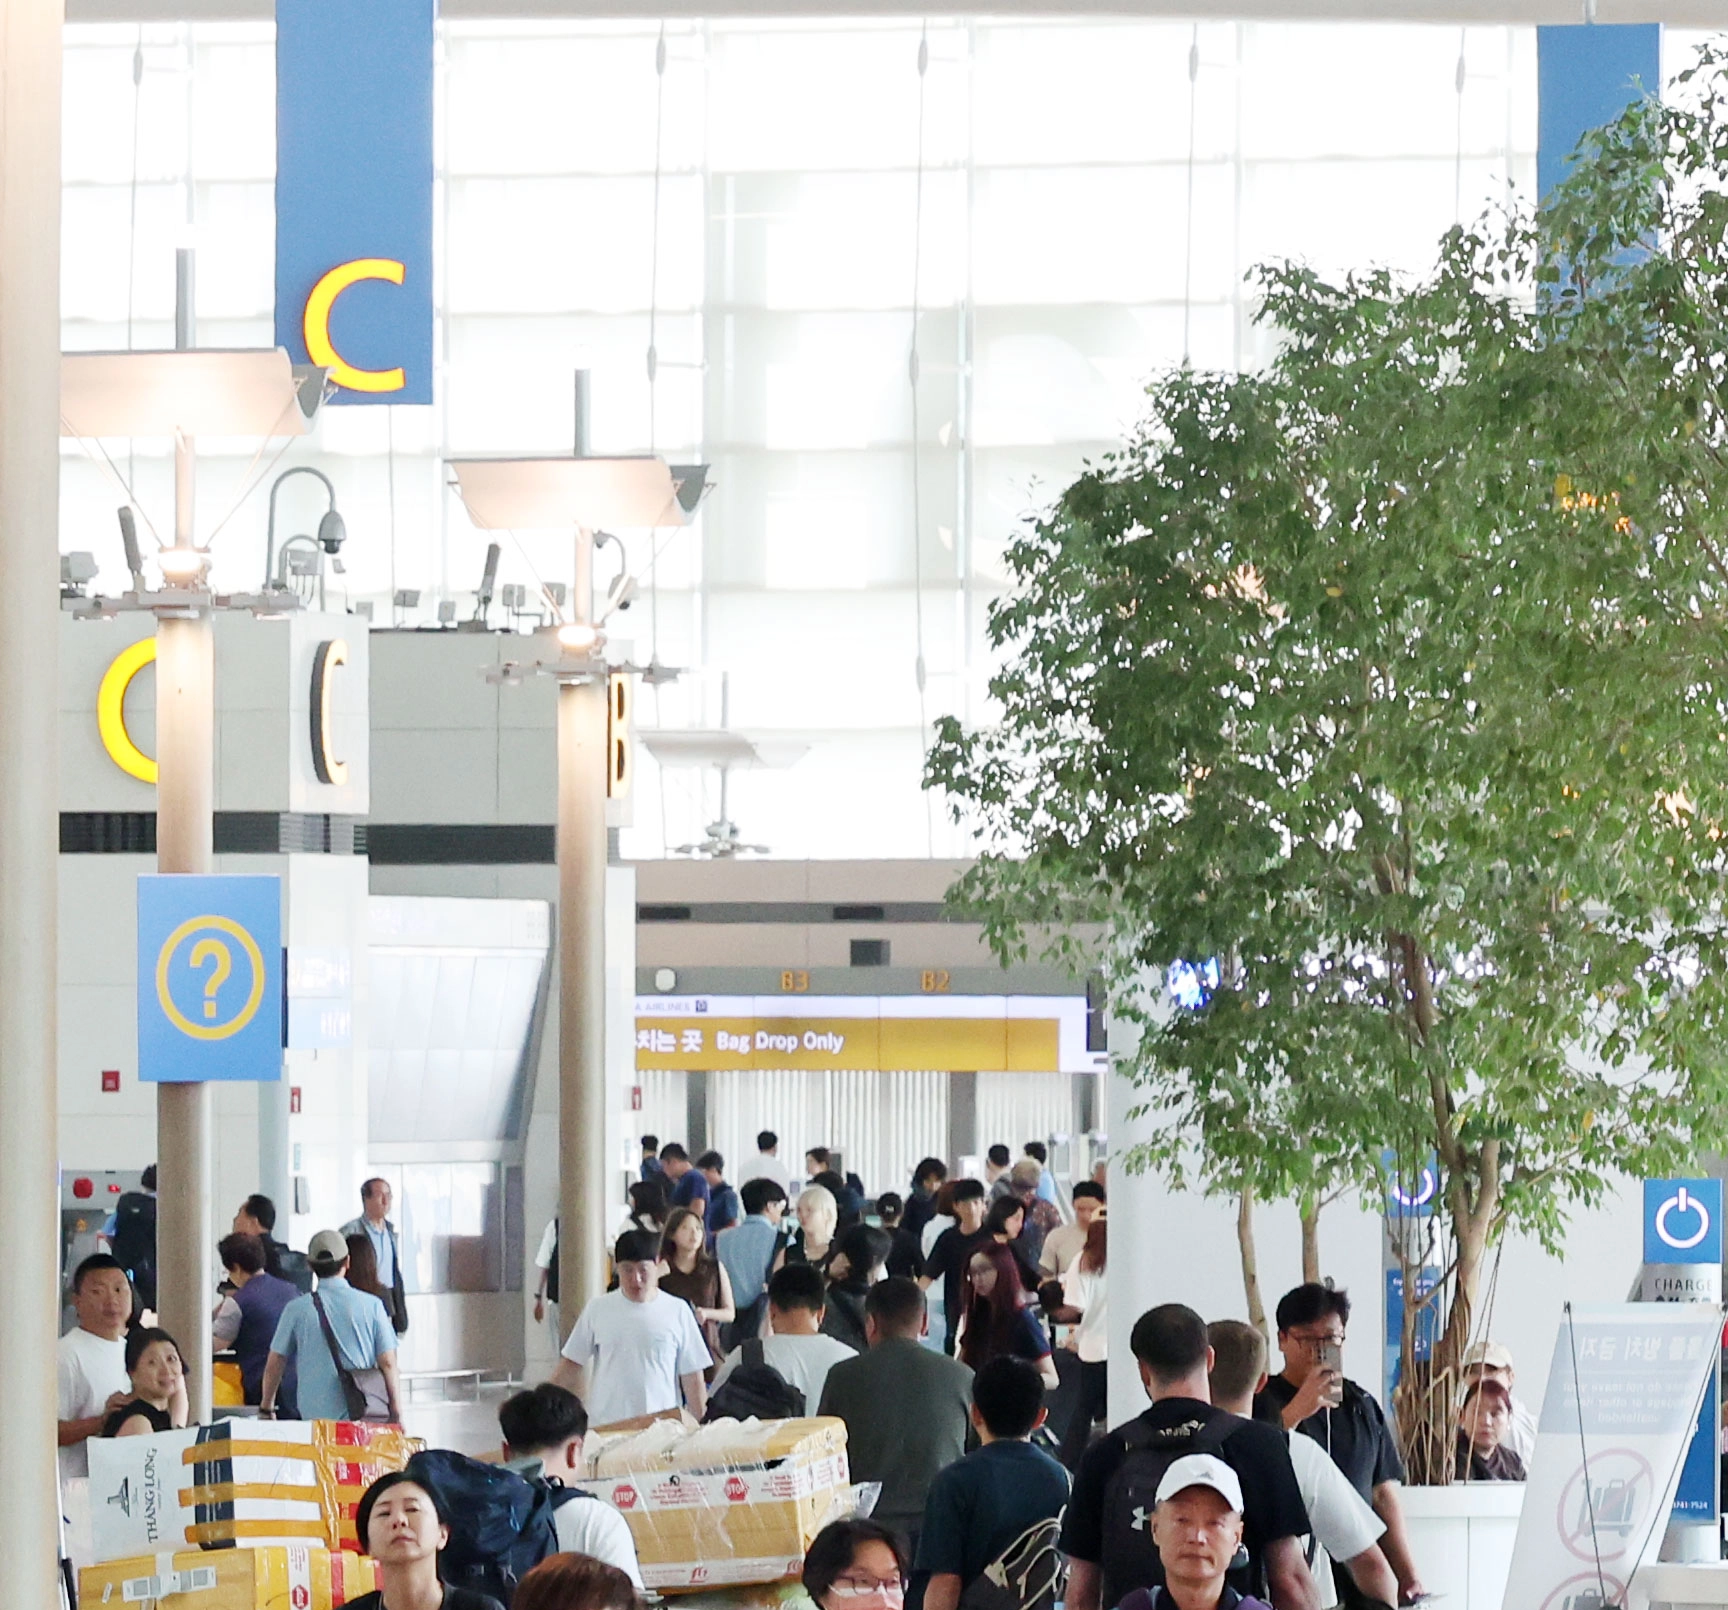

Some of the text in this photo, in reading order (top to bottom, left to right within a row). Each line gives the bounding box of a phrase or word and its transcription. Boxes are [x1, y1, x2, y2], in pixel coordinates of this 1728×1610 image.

[303, 258, 406, 392] C
[781, 970, 810, 993] B3
[634, 1028, 844, 1054] 치는 곳 Bag Drop Only
[613, 1490, 634, 1503] STOP
